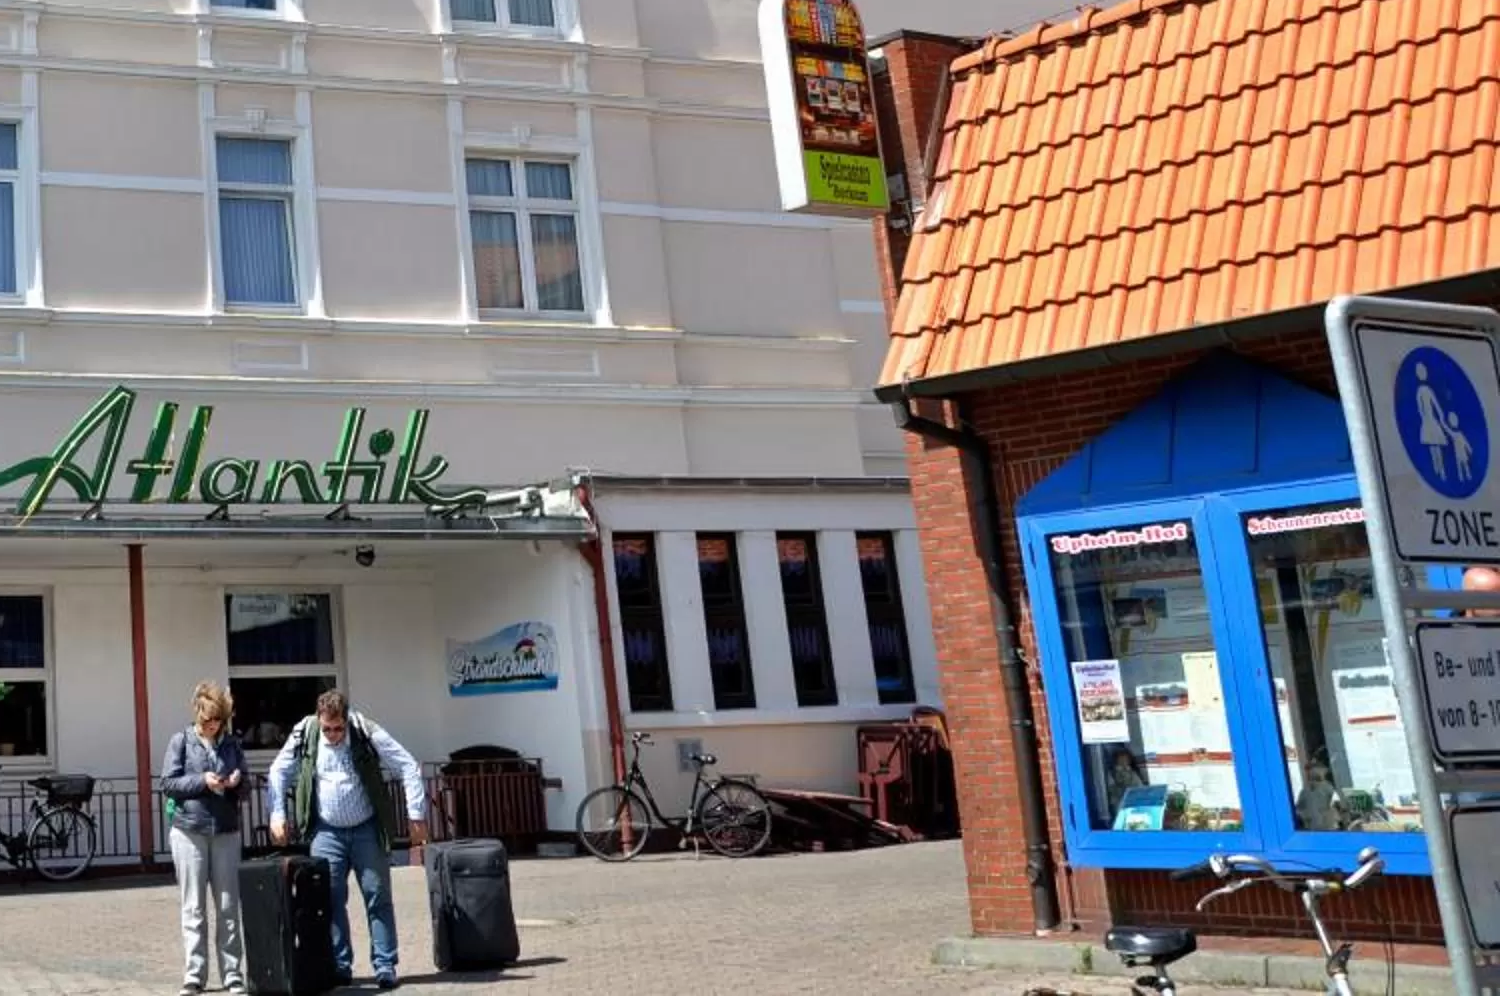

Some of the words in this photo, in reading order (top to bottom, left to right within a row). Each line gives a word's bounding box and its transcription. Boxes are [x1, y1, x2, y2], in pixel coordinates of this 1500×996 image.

[1053, 524, 1186, 553] Upholm-Hof
[1425, 508, 1499, 547] ZONE
[1434, 651, 1462, 678] Be-
[1468, 651, 1495, 677] und
[1437, 707, 1465, 728] von
